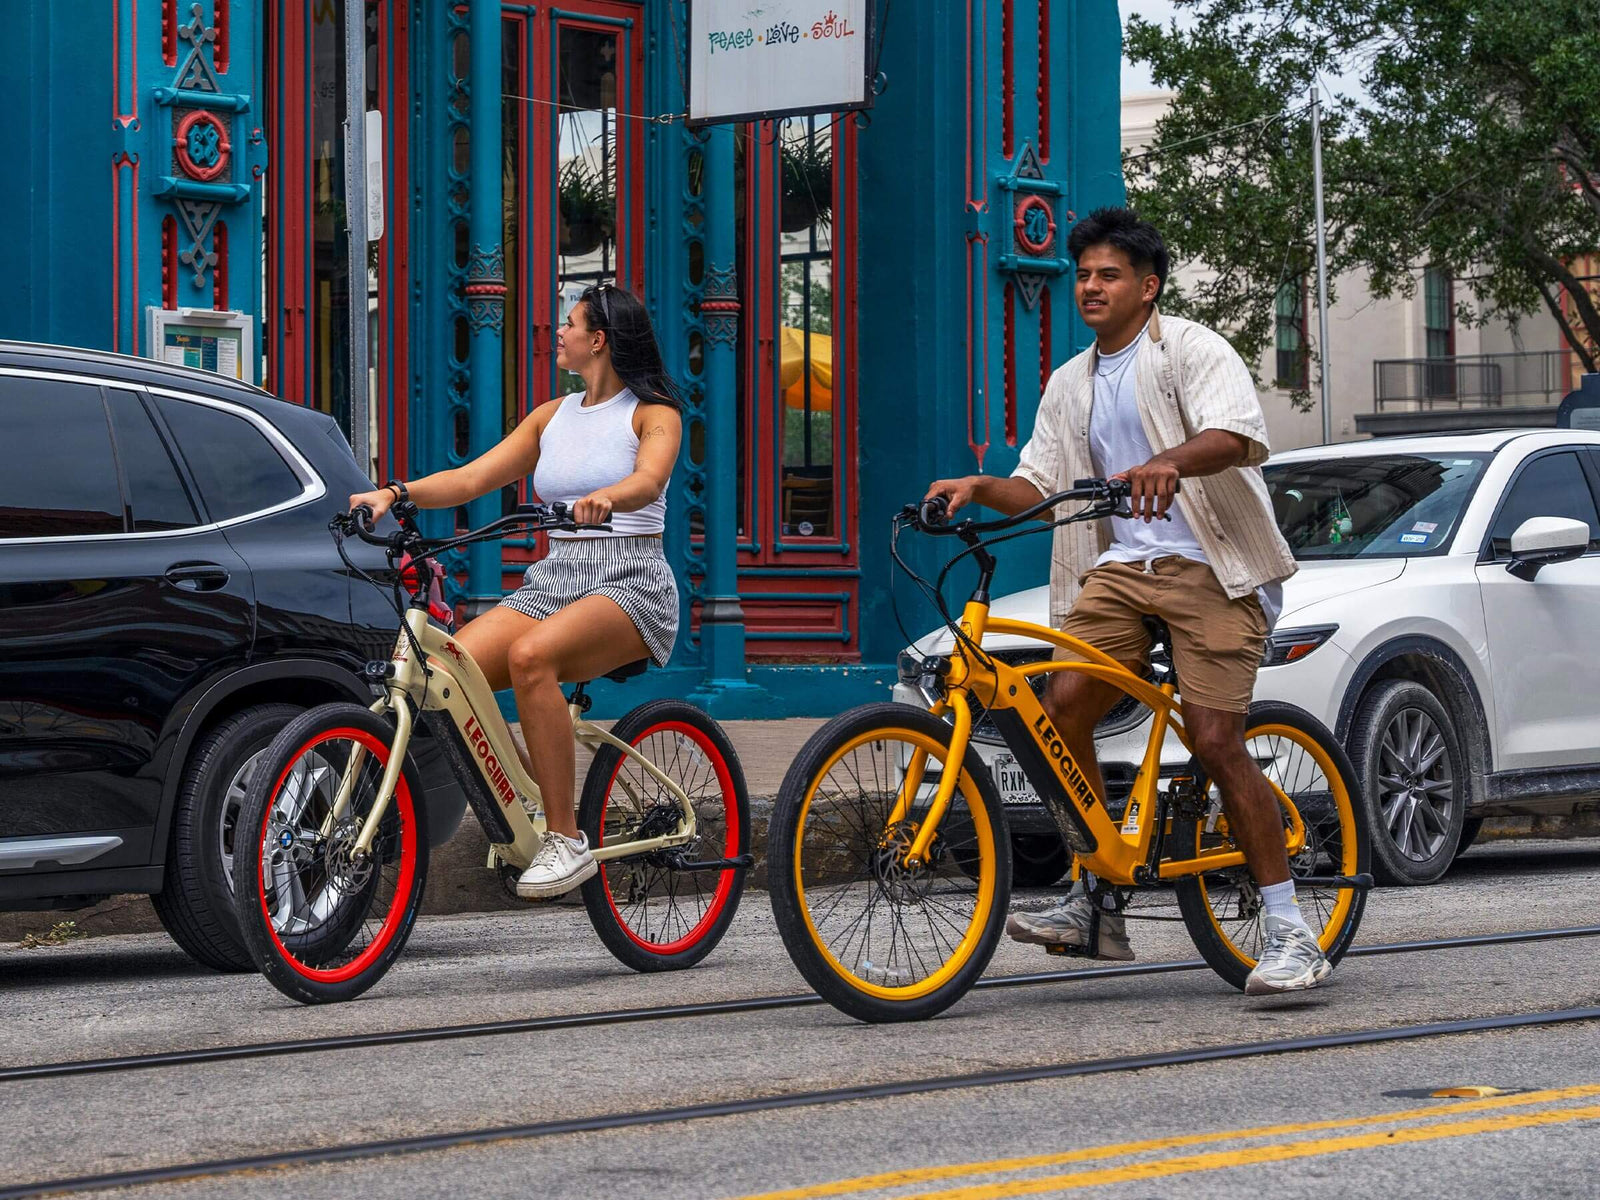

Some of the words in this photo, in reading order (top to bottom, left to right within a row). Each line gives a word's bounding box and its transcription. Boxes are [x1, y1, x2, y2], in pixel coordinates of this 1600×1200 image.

[709, 28, 754, 54] PEACE
[765, 21, 799, 46] LOVE
[811, 17, 854, 40] SOUL
[463, 715, 516, 809] LEOGUAR
[1033, 713, 1097, 813] LEOGUAR
